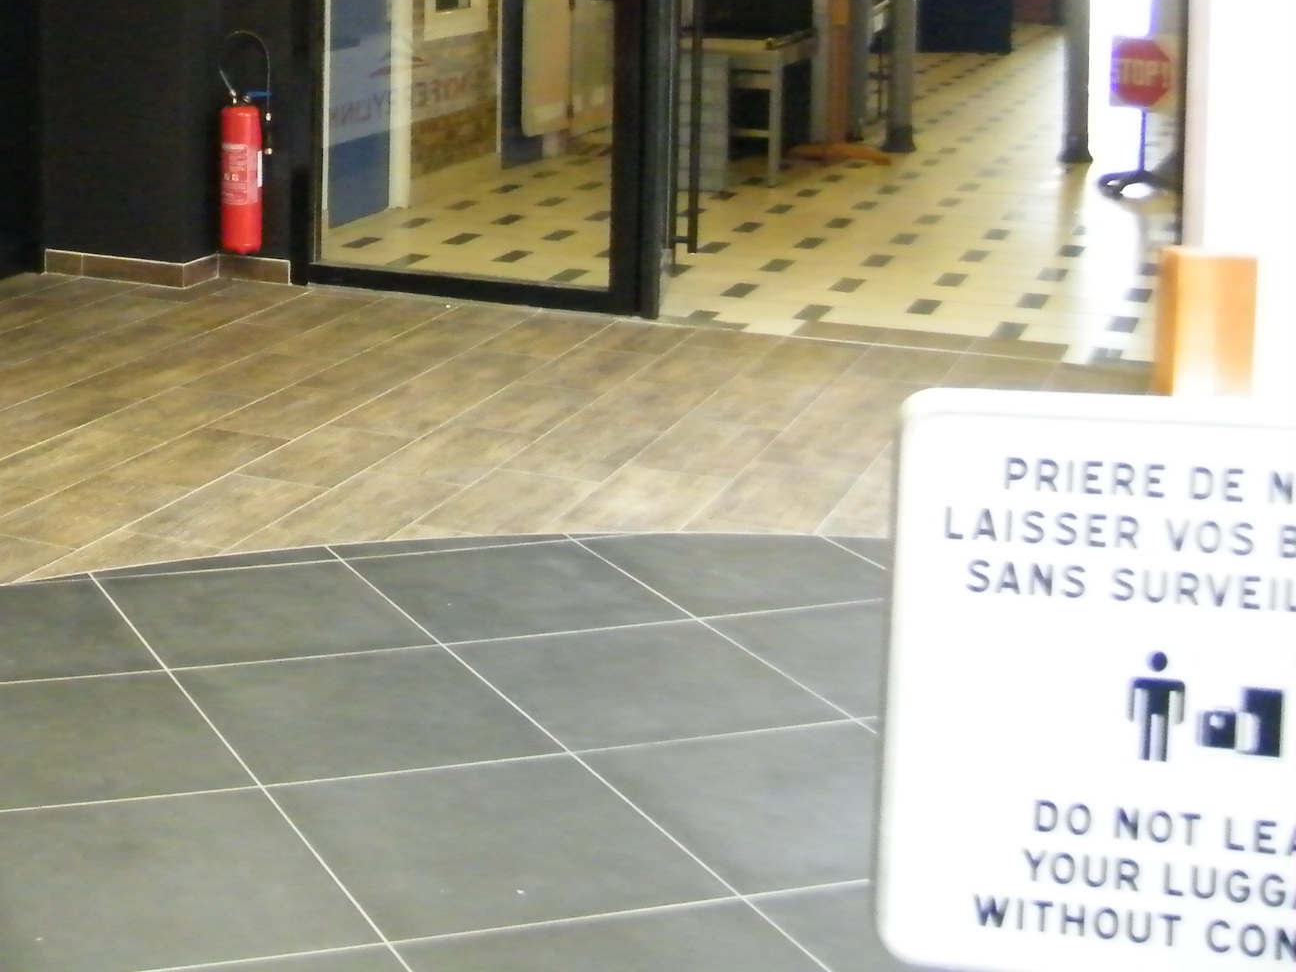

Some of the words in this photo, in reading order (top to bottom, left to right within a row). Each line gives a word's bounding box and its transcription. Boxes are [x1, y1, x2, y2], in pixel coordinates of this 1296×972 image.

[1004, 456, 1167, 499] PRIERE
[1189, 466, 1245, 503] DE
[945, 506, 1140, 550] LAISSER
[1167, 517, 1255, 557] VOS
[966, 558, 1086, 599] SANS
[1033, 799, 1093, 836] DO
[1114, 808, 1202, 846] NOT
[1022, 848, 1142, 893] YOUR
[1163, 863, 1296, 909] LUGG
[972, 894, 1183, 947] WITHOUT
